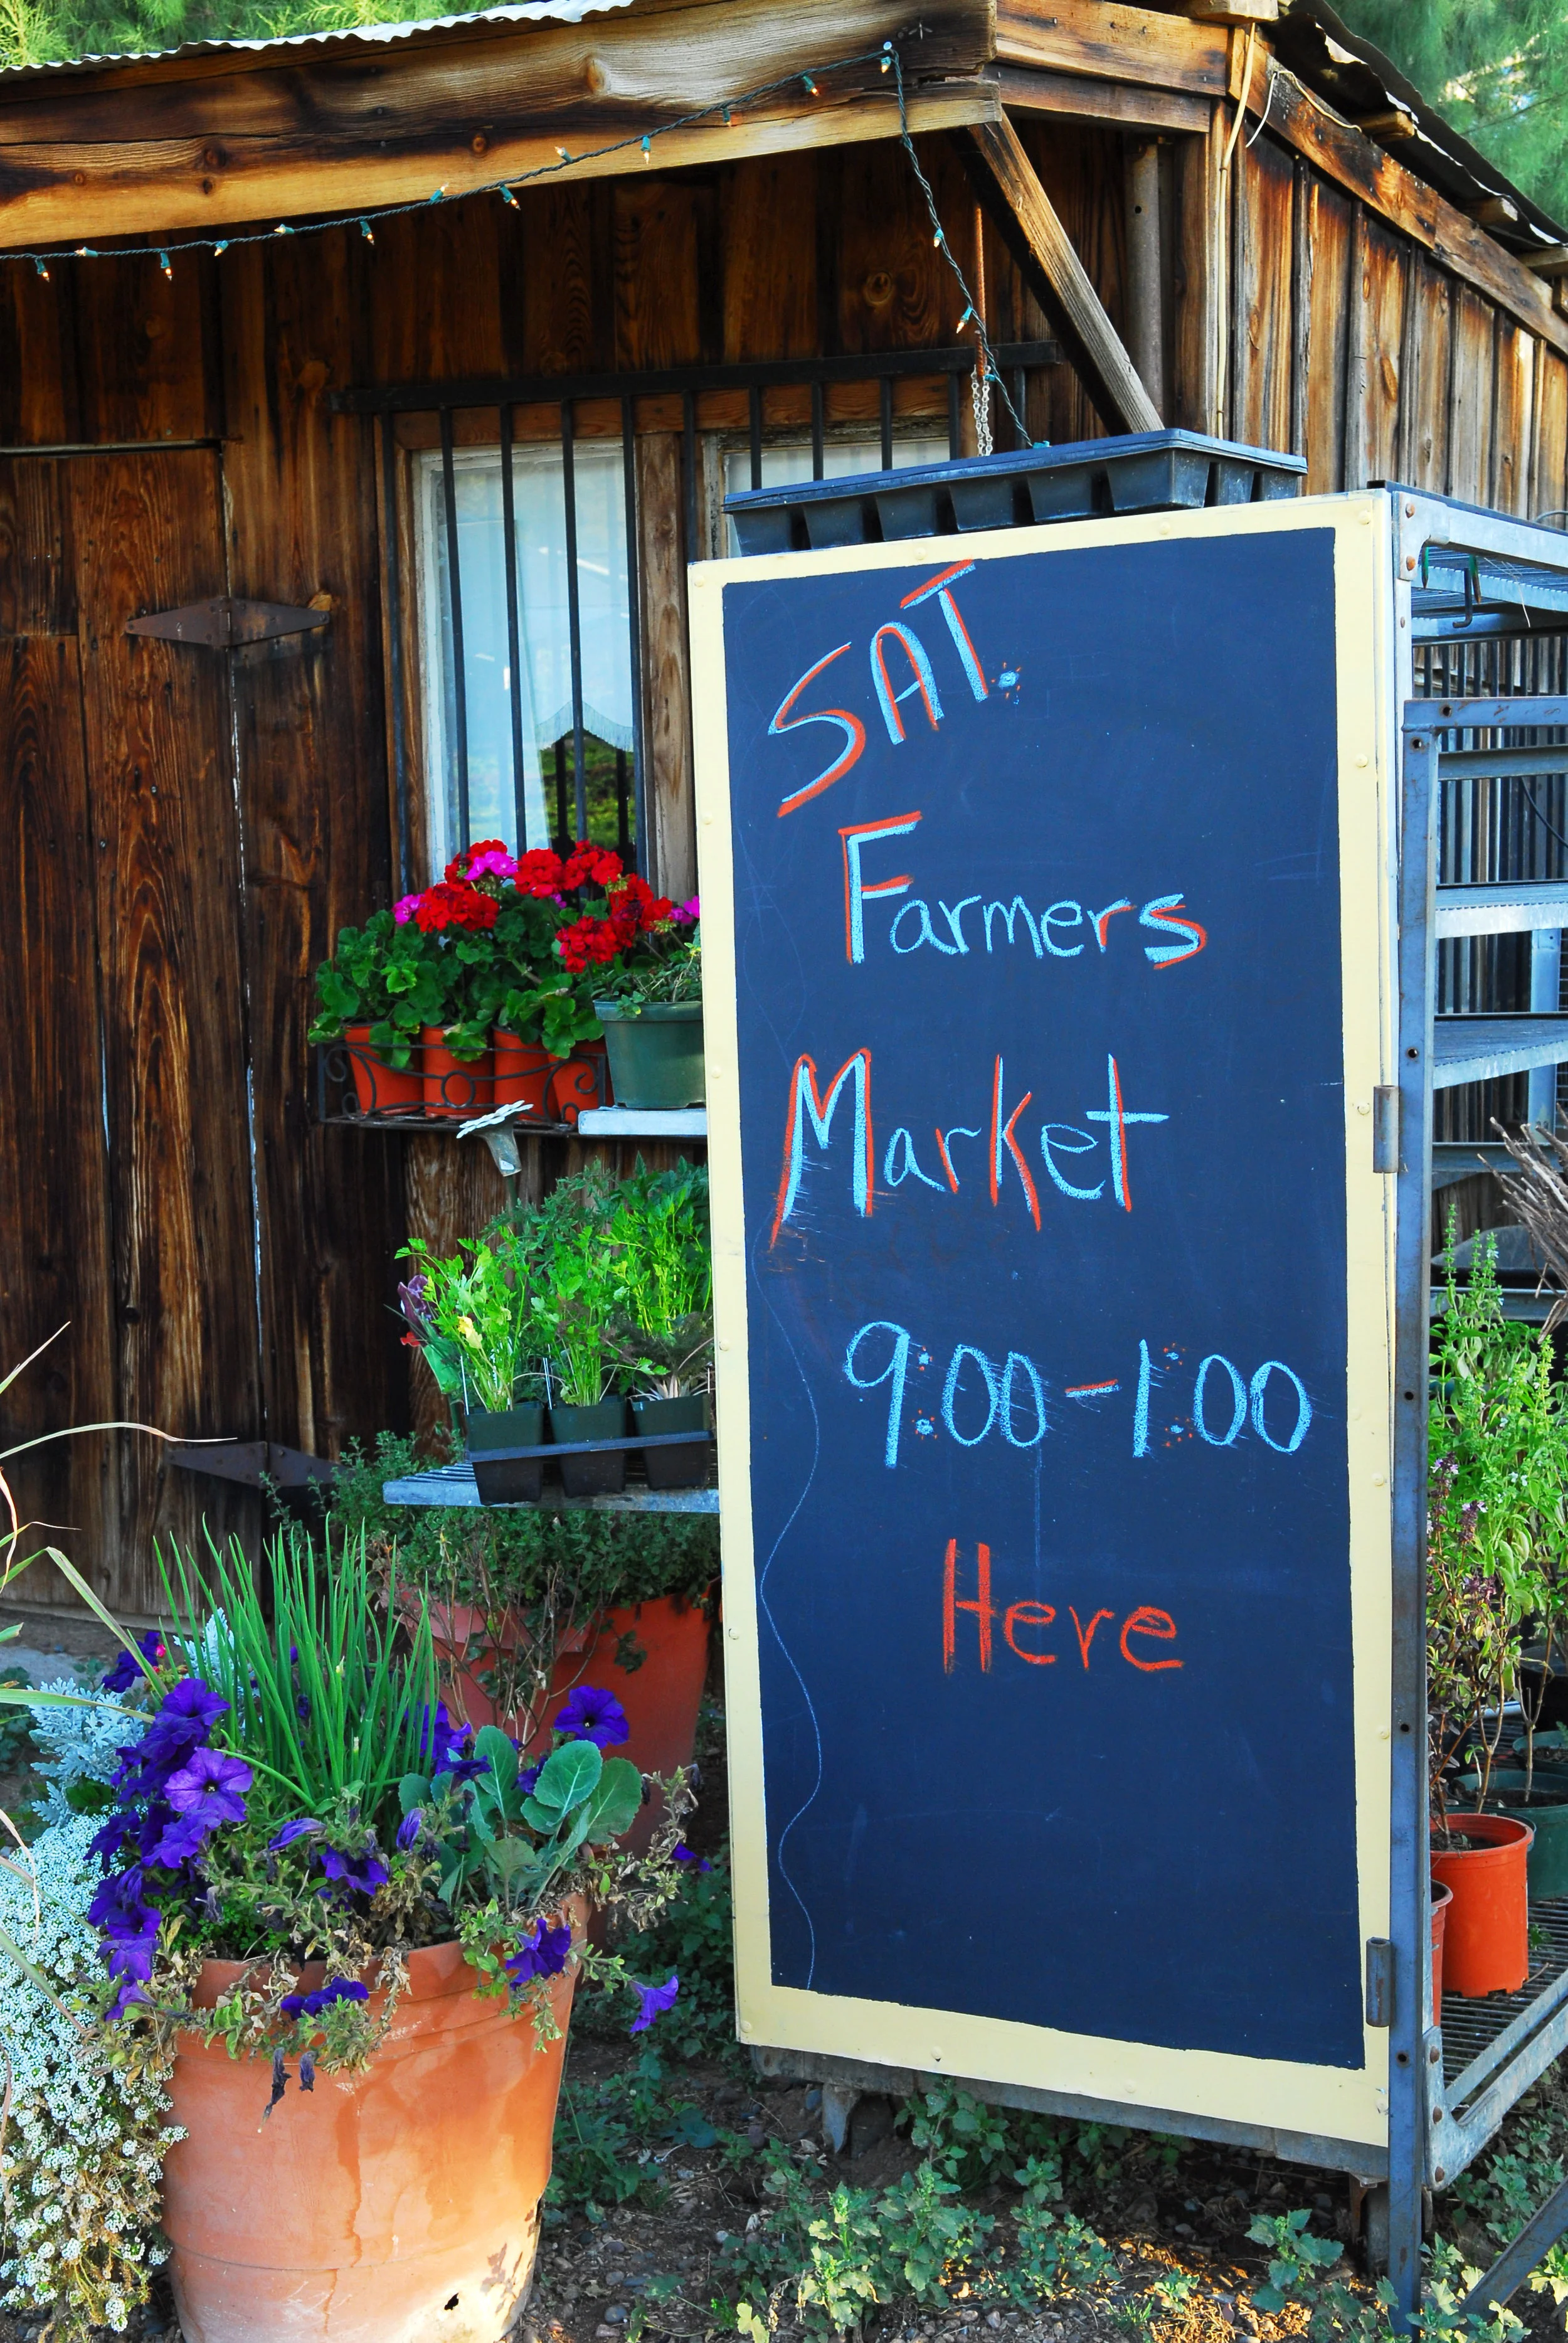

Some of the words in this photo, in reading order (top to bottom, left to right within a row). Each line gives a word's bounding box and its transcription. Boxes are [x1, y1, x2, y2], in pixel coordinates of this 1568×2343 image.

[768, 559, 1021, 817] SAT.
[838, 811, 1207, 970] Farmers
[770, 1047, 1170, 1248] Market
[943, 1539, 1184, 1674] Here
